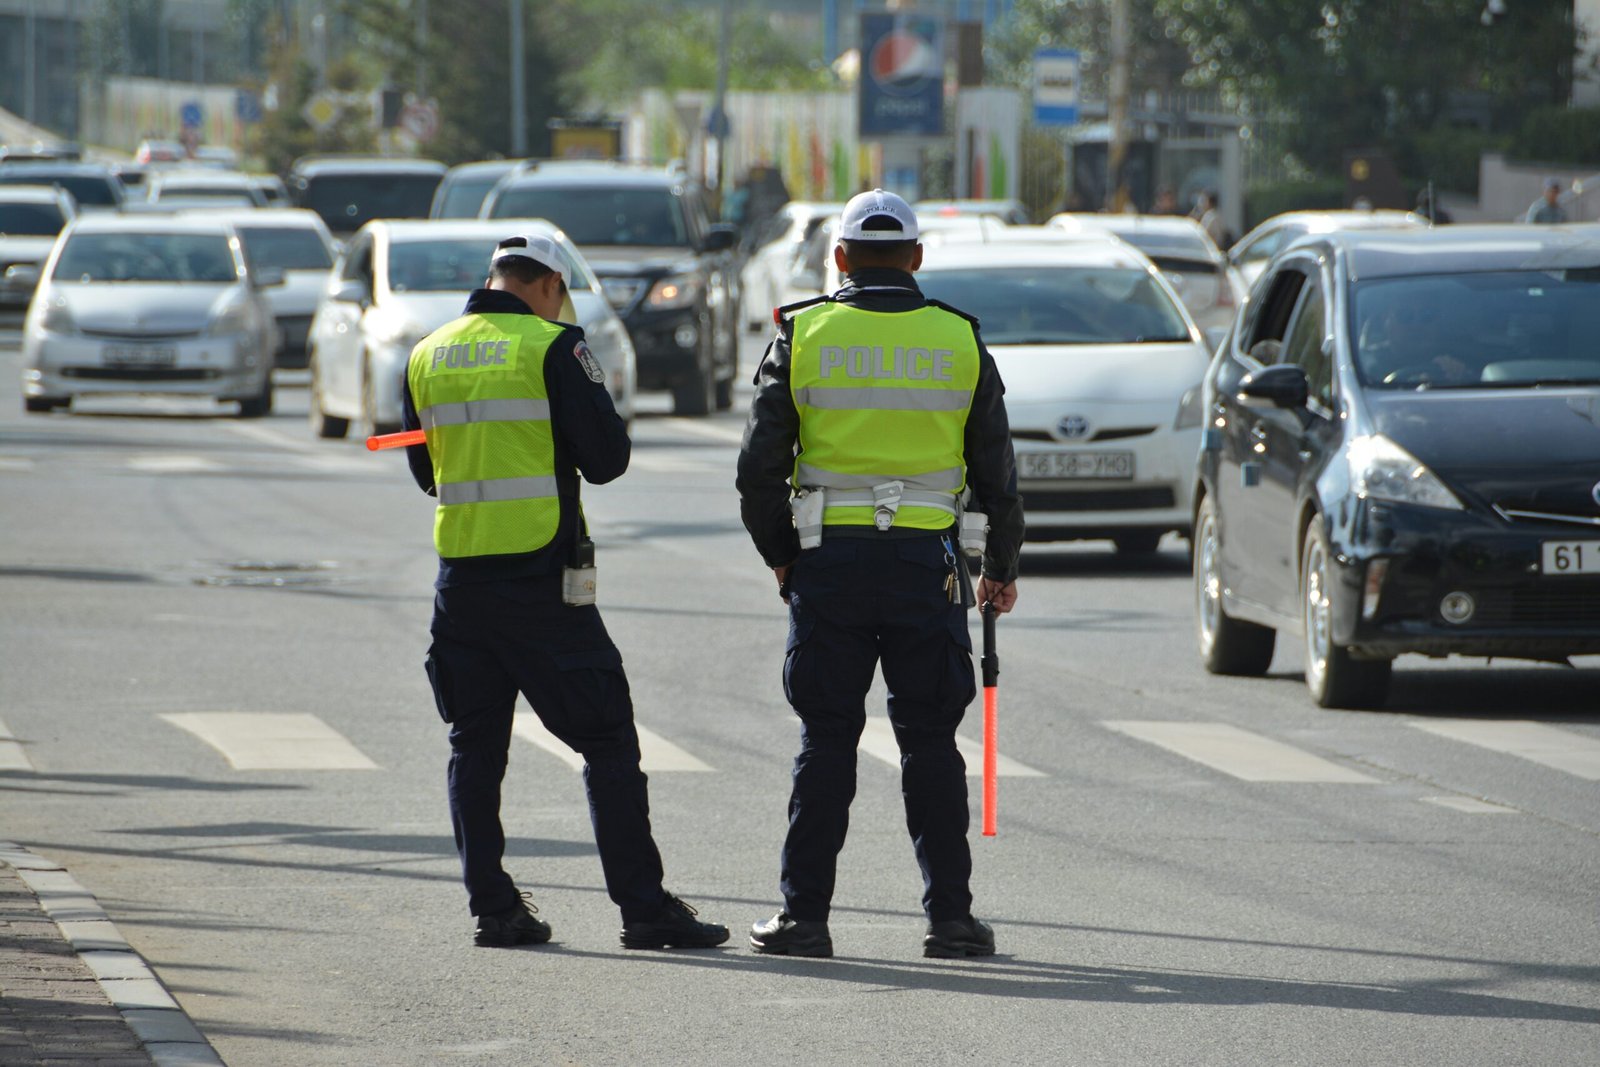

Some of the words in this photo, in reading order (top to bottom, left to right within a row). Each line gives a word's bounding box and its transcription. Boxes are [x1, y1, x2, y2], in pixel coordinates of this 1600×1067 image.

[866, 205, 896, 213] POLICE
[432, 339, 512, 371] POLICE
[820, 346, 954, 382] POLICE
[1554, 545, 1583, 571] 61
